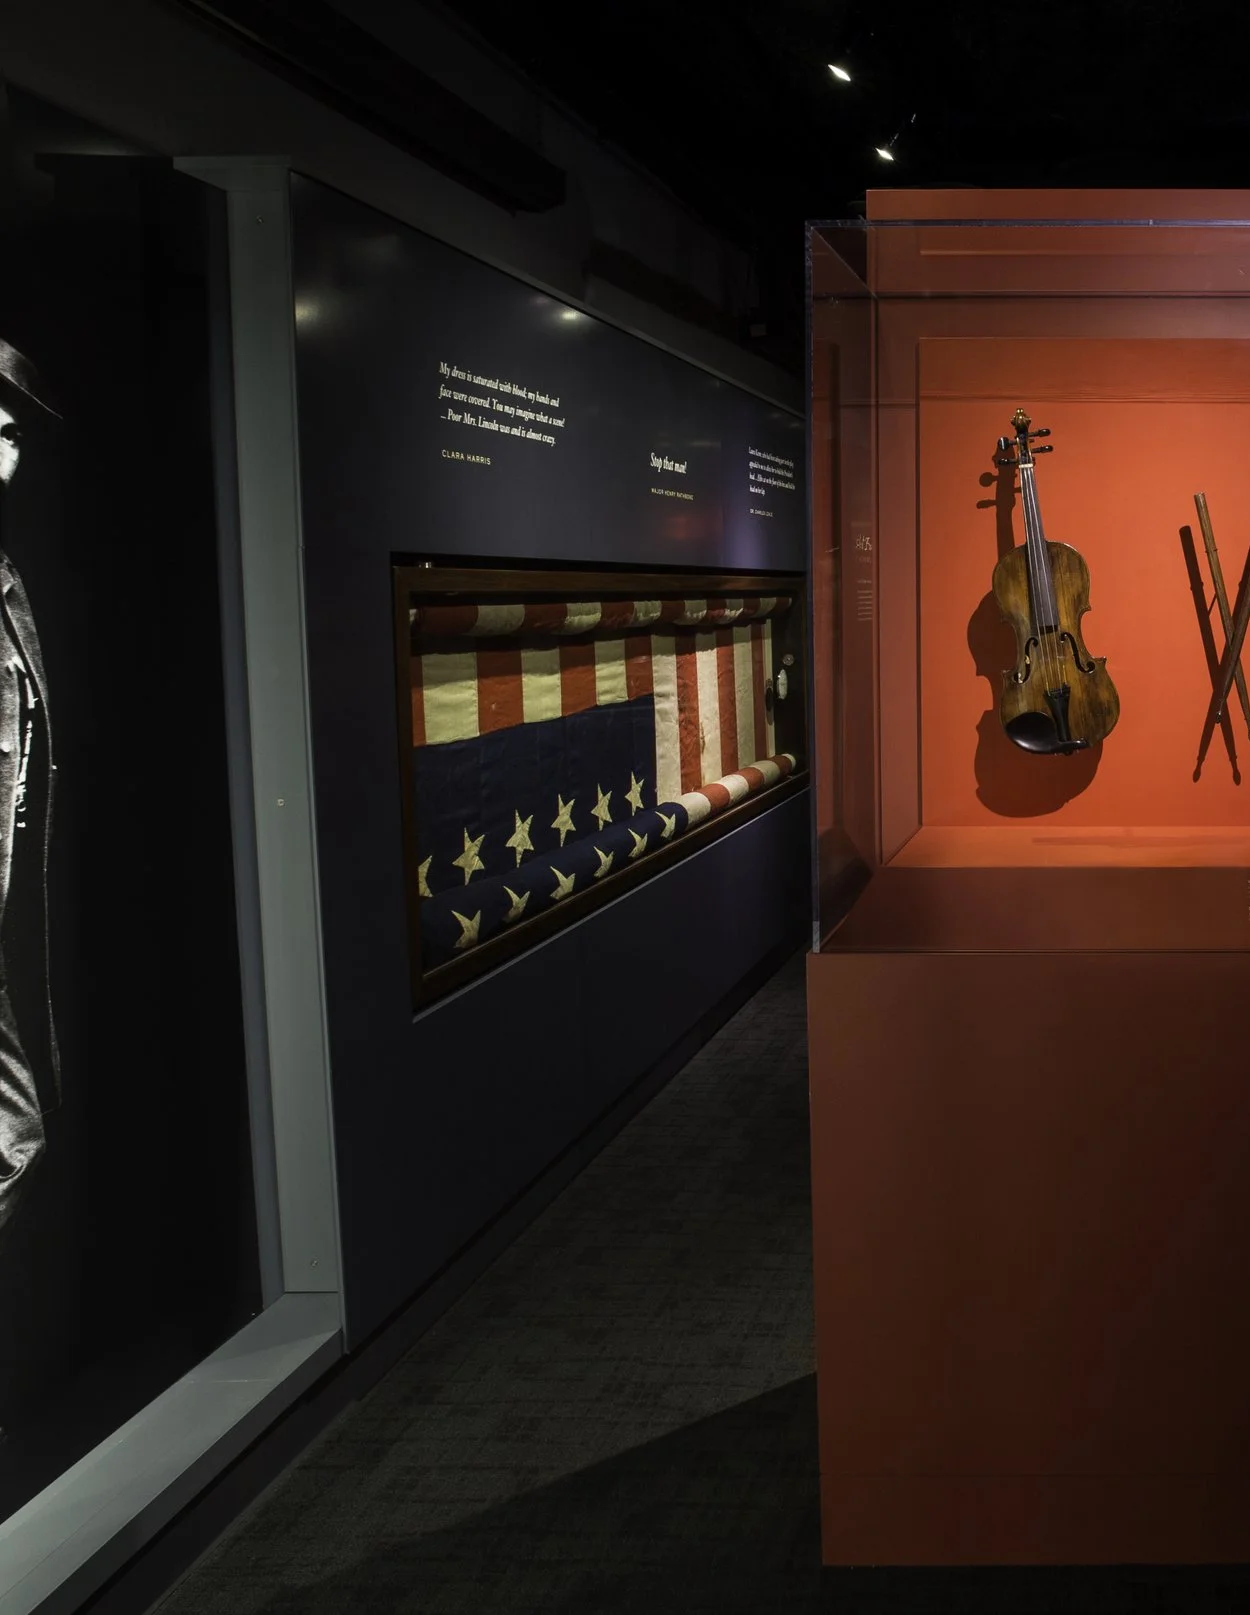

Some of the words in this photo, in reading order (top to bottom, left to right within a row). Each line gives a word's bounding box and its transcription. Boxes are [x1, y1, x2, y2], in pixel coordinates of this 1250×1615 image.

[439, 361, 450, 378] My
[452, 366, 466, 380] dress
[467, 370, 472, 382] is
[473, 375, 498, 390] saturated
[499, 382, 512, 393] with
[528, 392, 536, 404] my
[536, 392, 550, 404] hands
[550, 398, 560, 408] and
[438, 384, 452, 399] face
[453, 391, 467, 402] were
[468, 397, 491, 408] covered.
[492, 398, 504, 412] You
[504, 405, 516, 418] may
[516, 406, 536, 421] imagine
[536, 412, 548, 423] what
[448, 408, 462, 422] Poor
[463, 412, 477, 426] Mrs.
[478, 416, 498, 431] Lincoln
[500, 424, 510, 434] was
[511, 426, 521, 436] and
[522, 427, 526, 438] is
[526, 428, 542, 440] almost
[442, 450, 464, 460] CLARA
[467, 454, 491, 465] HARRIS
[650, 452, 662, 472] Stop
[663, 456, 674, 470] that
[674, 461, 687, 474] man!
